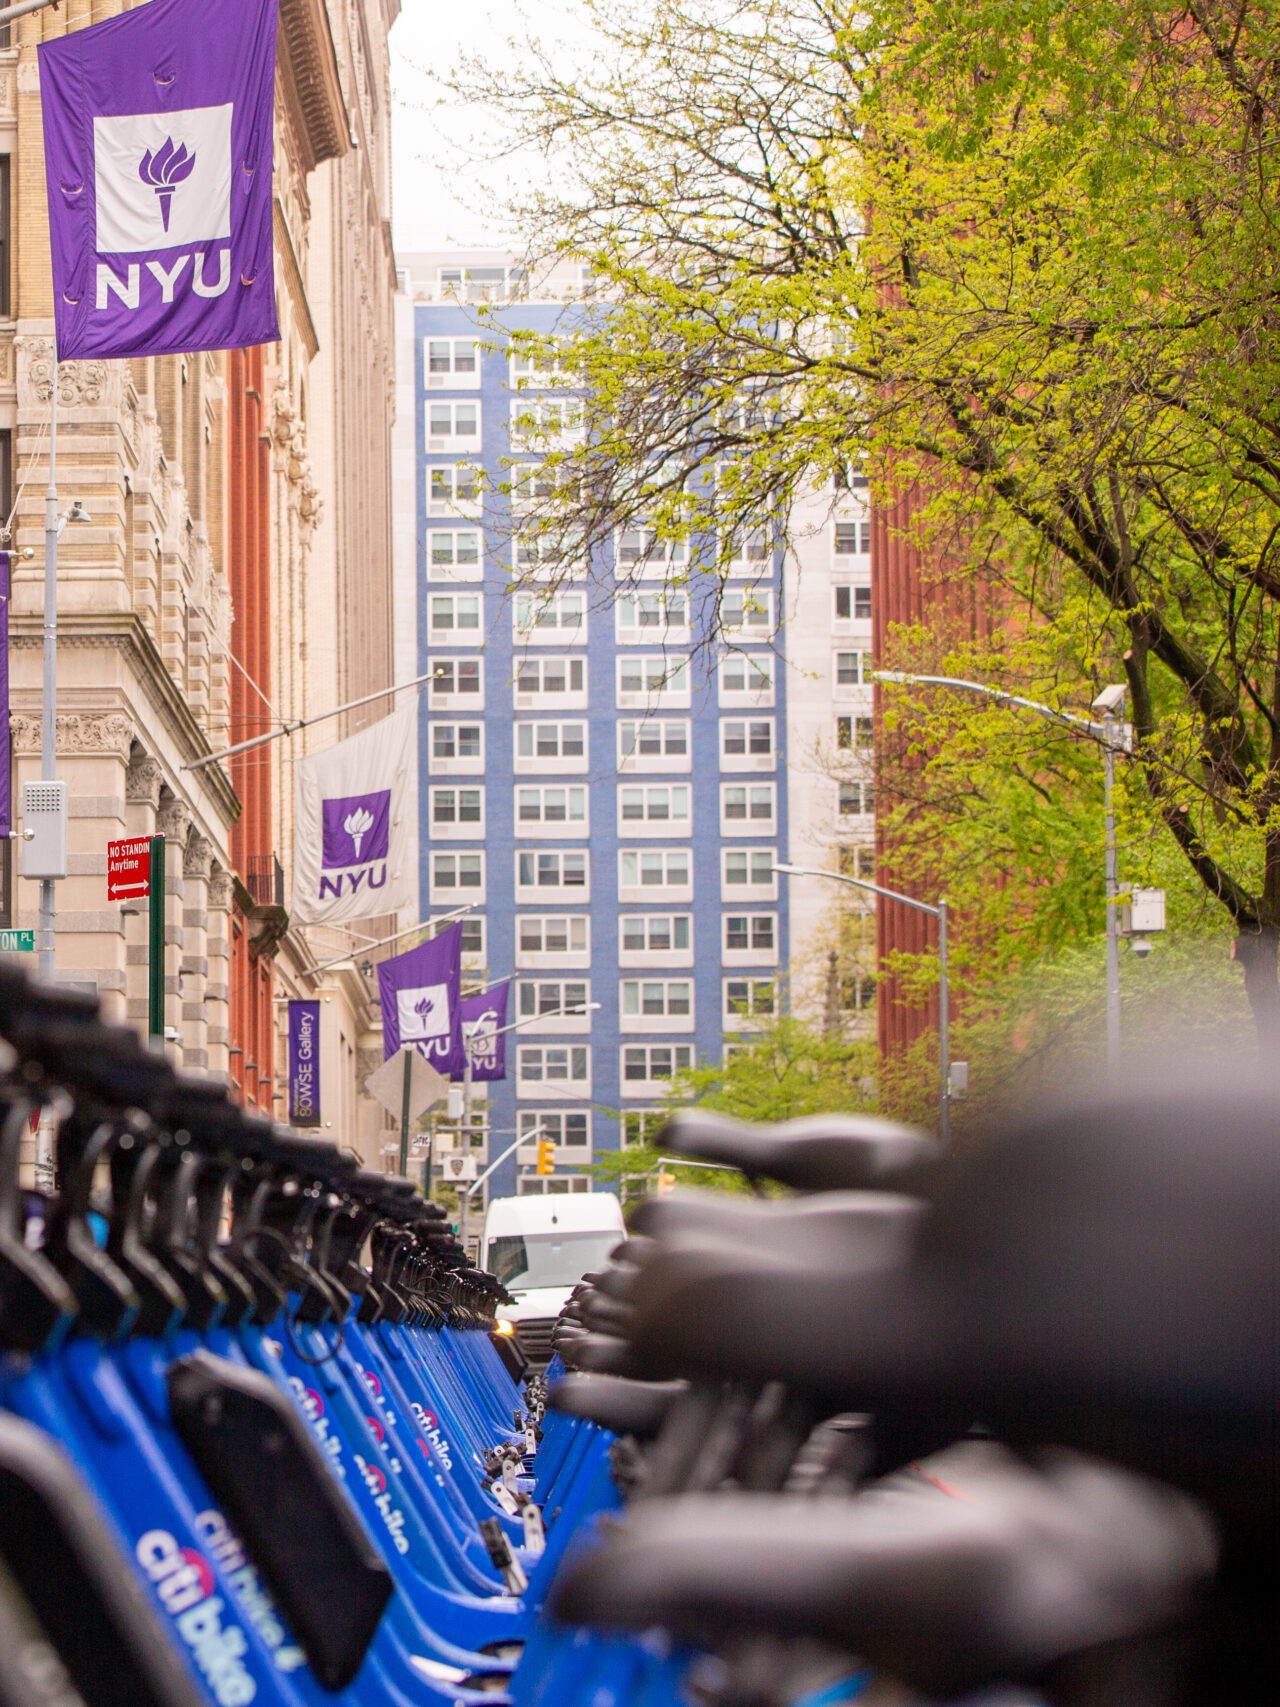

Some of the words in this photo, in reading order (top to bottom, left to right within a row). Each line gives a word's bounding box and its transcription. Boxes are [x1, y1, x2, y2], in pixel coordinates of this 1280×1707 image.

[95, 248, 231, 310] NYU
[110, 846, 120, 858] NO
[121, 841, 150, 857] STANDIN
[110, 858, 139, 873] Anytime
[319, 863, 387, 899] NYU
[20, 932, 33, 942] PL
[298, 1012, 314, 1060] Gallery
